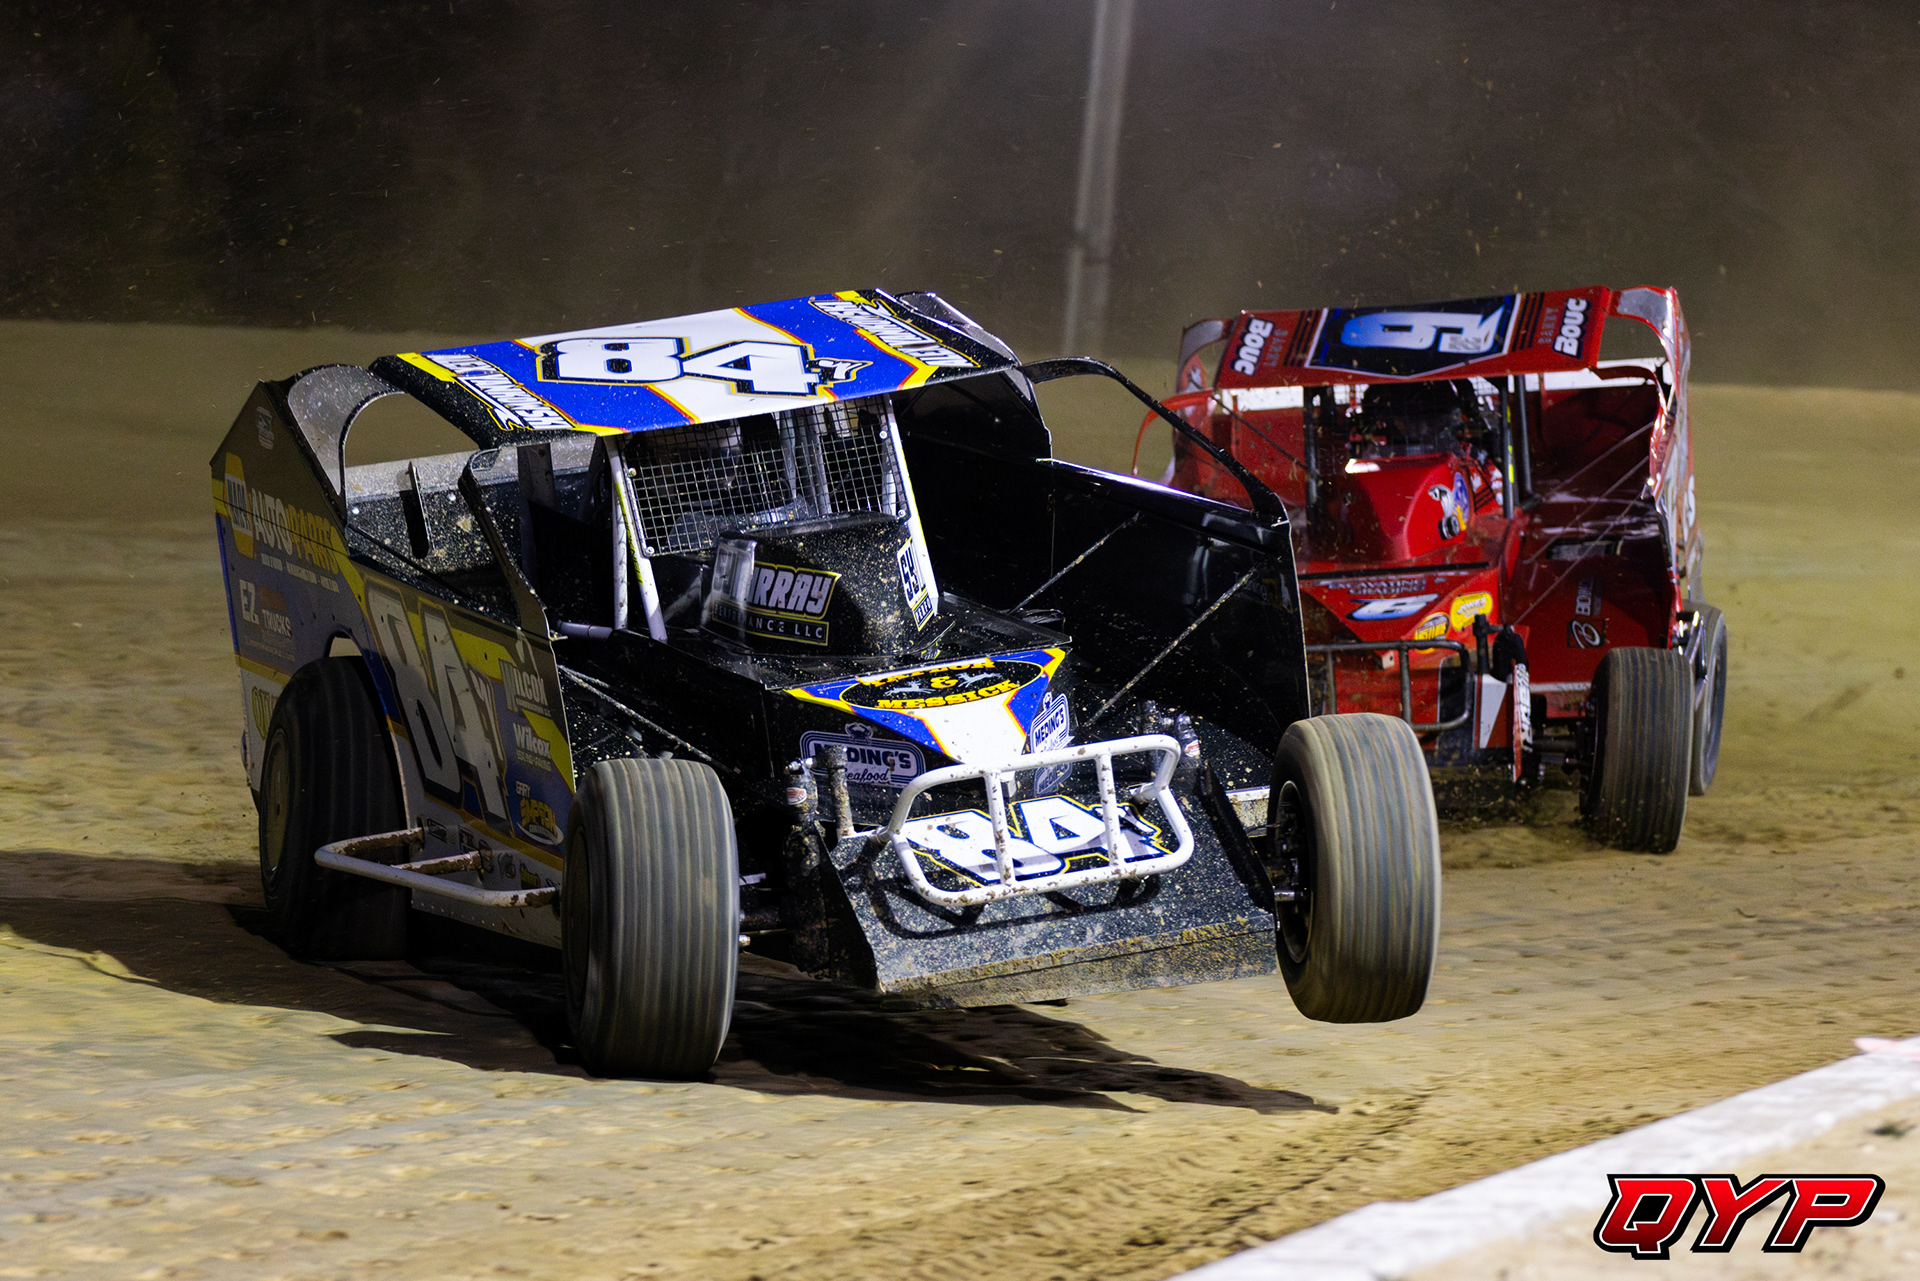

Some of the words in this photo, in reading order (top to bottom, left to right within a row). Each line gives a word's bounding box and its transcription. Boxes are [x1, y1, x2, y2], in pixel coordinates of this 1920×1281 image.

[251, 487, 293, 556] AUTO
[287, 503, 339, 575] PARTS
[239, 578, 260, 626] EZ
[261, 608, 292, 639] TRUCKS
[794, 623, 823, 639] LLC
[498, 658, 549, 713] WILCOX
[876, 680, 1021, 709] MESSICK
[930, 676, 959, 690] &
[513, 722, 551, 759] Wilcox
[1034, 706, 1065, 748] MEDING'S
[845, 768, 892, 784] eafood
